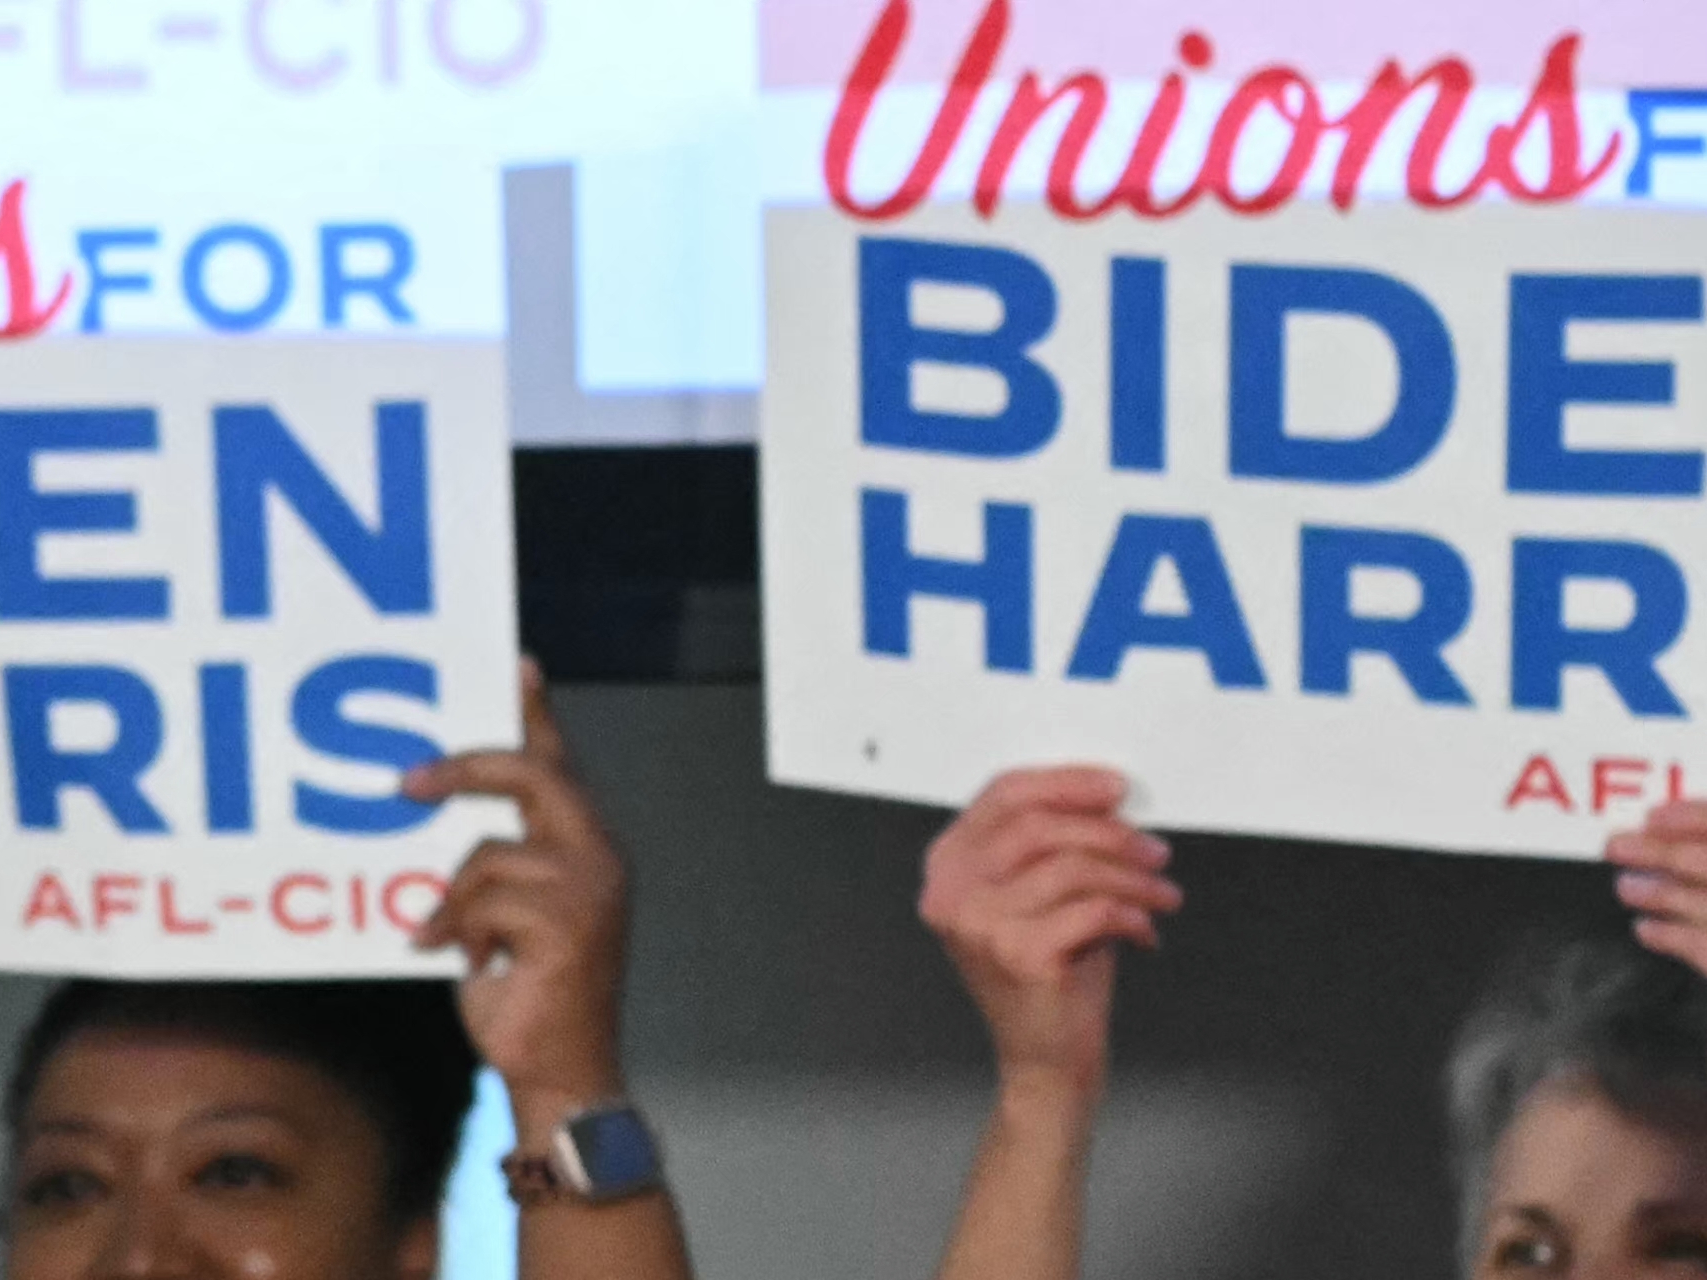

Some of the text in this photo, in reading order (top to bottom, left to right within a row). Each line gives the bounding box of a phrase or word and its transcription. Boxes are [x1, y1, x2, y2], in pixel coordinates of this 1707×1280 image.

[823, 0, 1623, 224] Unions
[75, 221, 419, 334] FOR
[857, 235, 1707, 499] BIDE
[859, 484, 1692, 722] HARR
